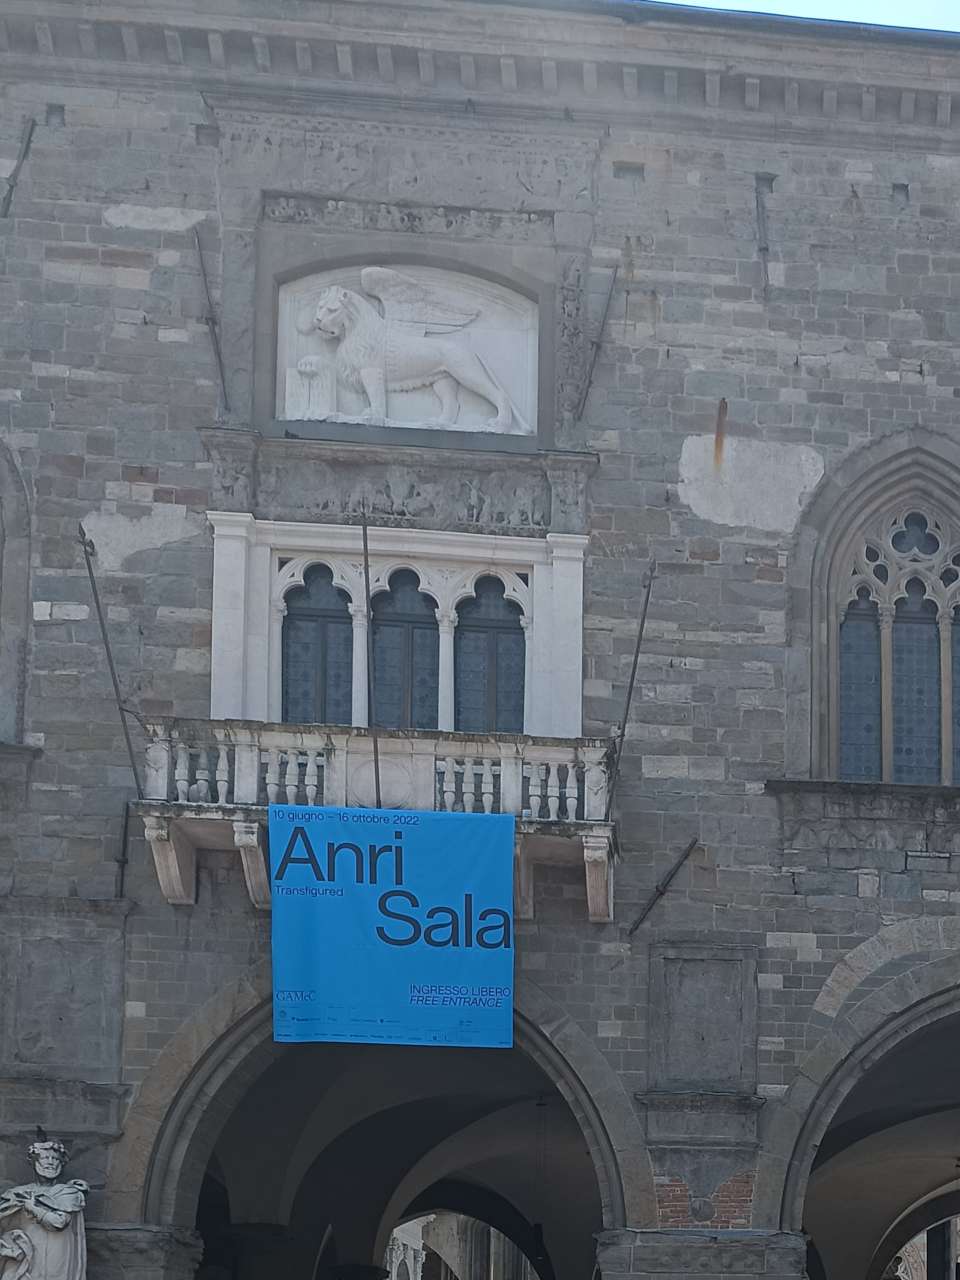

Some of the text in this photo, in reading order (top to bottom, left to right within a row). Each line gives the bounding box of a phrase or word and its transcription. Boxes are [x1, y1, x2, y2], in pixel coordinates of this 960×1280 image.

[273, 811, 285, 820] 10
[287, 812, 325, 823] giugno
[337, 813, 349, 823] 16
[352, 814, 390, 825] ottobre
[393, 815, 420, 826] 2022
[274, 826, 404, 886] Anri
[275, 885, 344, 897] Transfigured
[376, 889, 512, 949] Sala
[409, 984, 512, 998] INGRESSO LIBERO
[409, 995, 503, 1008] FREE ENTRANCE
